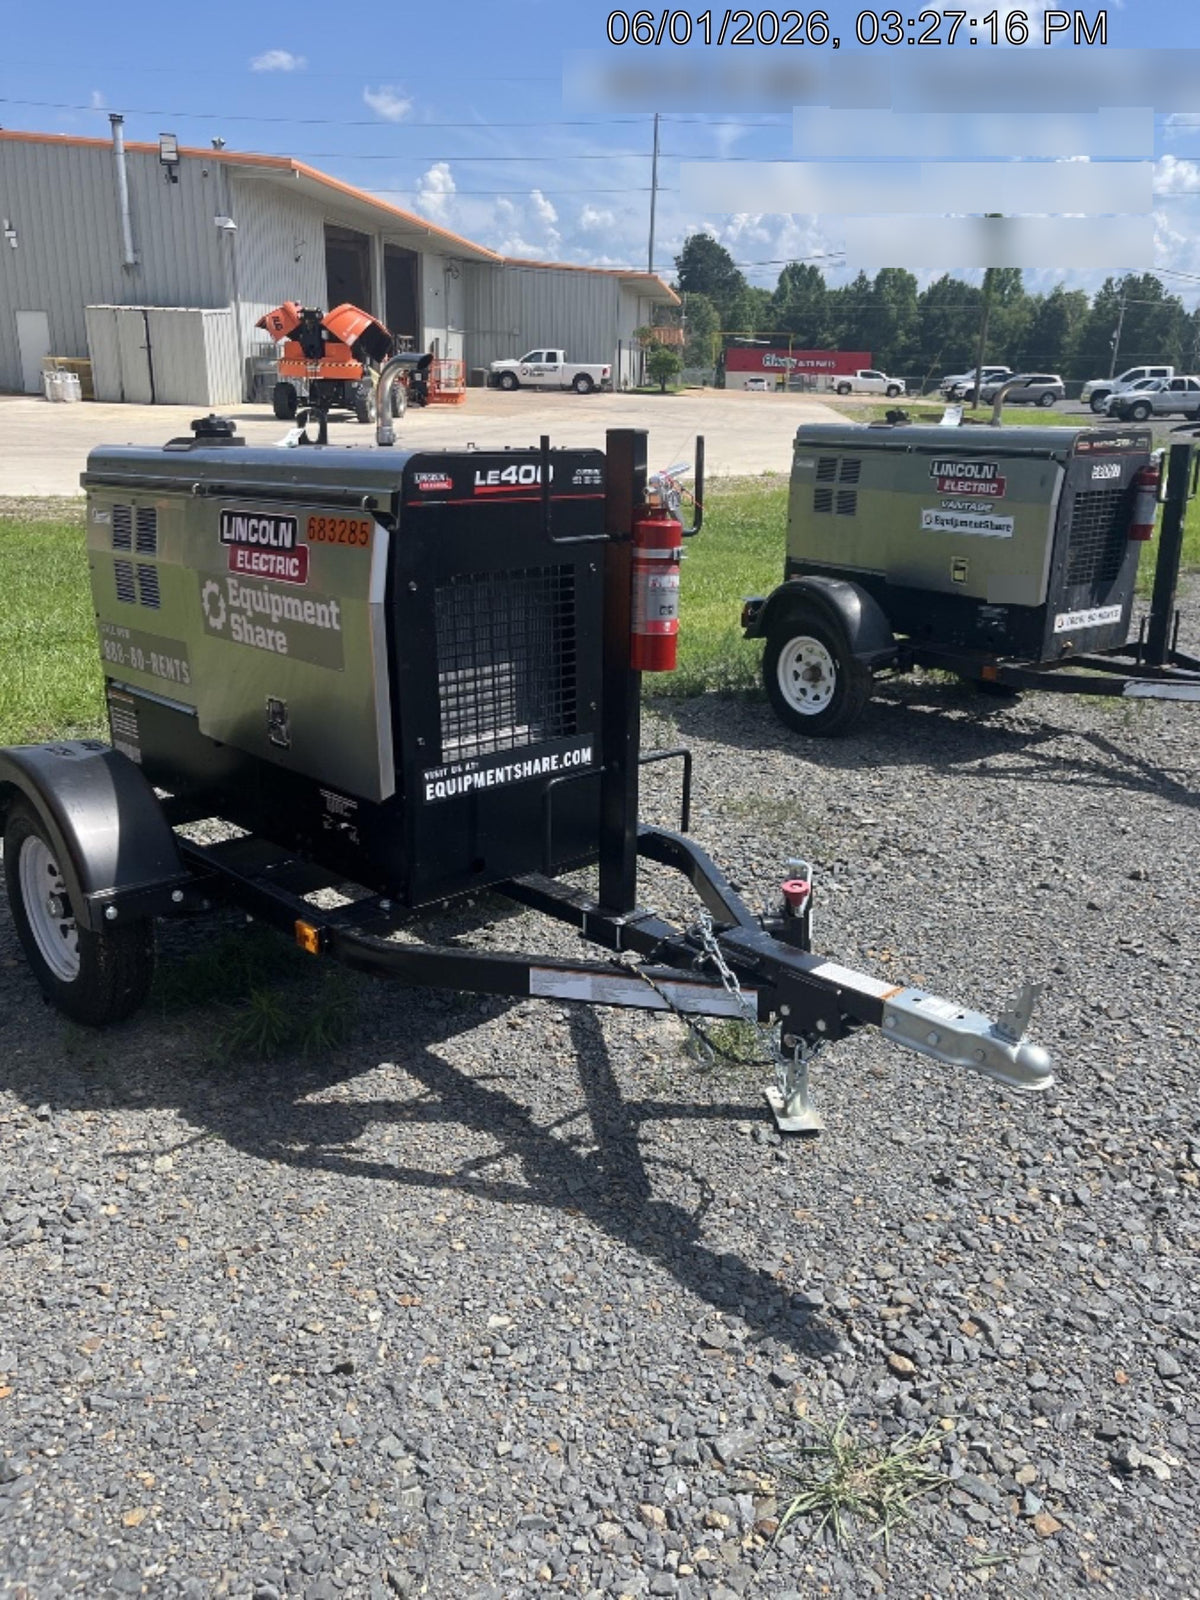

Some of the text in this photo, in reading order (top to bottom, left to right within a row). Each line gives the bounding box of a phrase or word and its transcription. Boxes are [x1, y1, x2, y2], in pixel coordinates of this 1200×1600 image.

[932, 462, 995, 479] LINCOLN
[943, 480, 998, 494] ELECTRIC
[223, 515, 293, 548] LINCOLN
[307, 516, 369, 546] 683285
[237, 550, 299, 577] ELECTRIC
[226, 577, 341, 630] Equipment
[230, 613, 288, 654] Share
[426, 746, 592, 801] EQUIPMENTSHARE.COM
